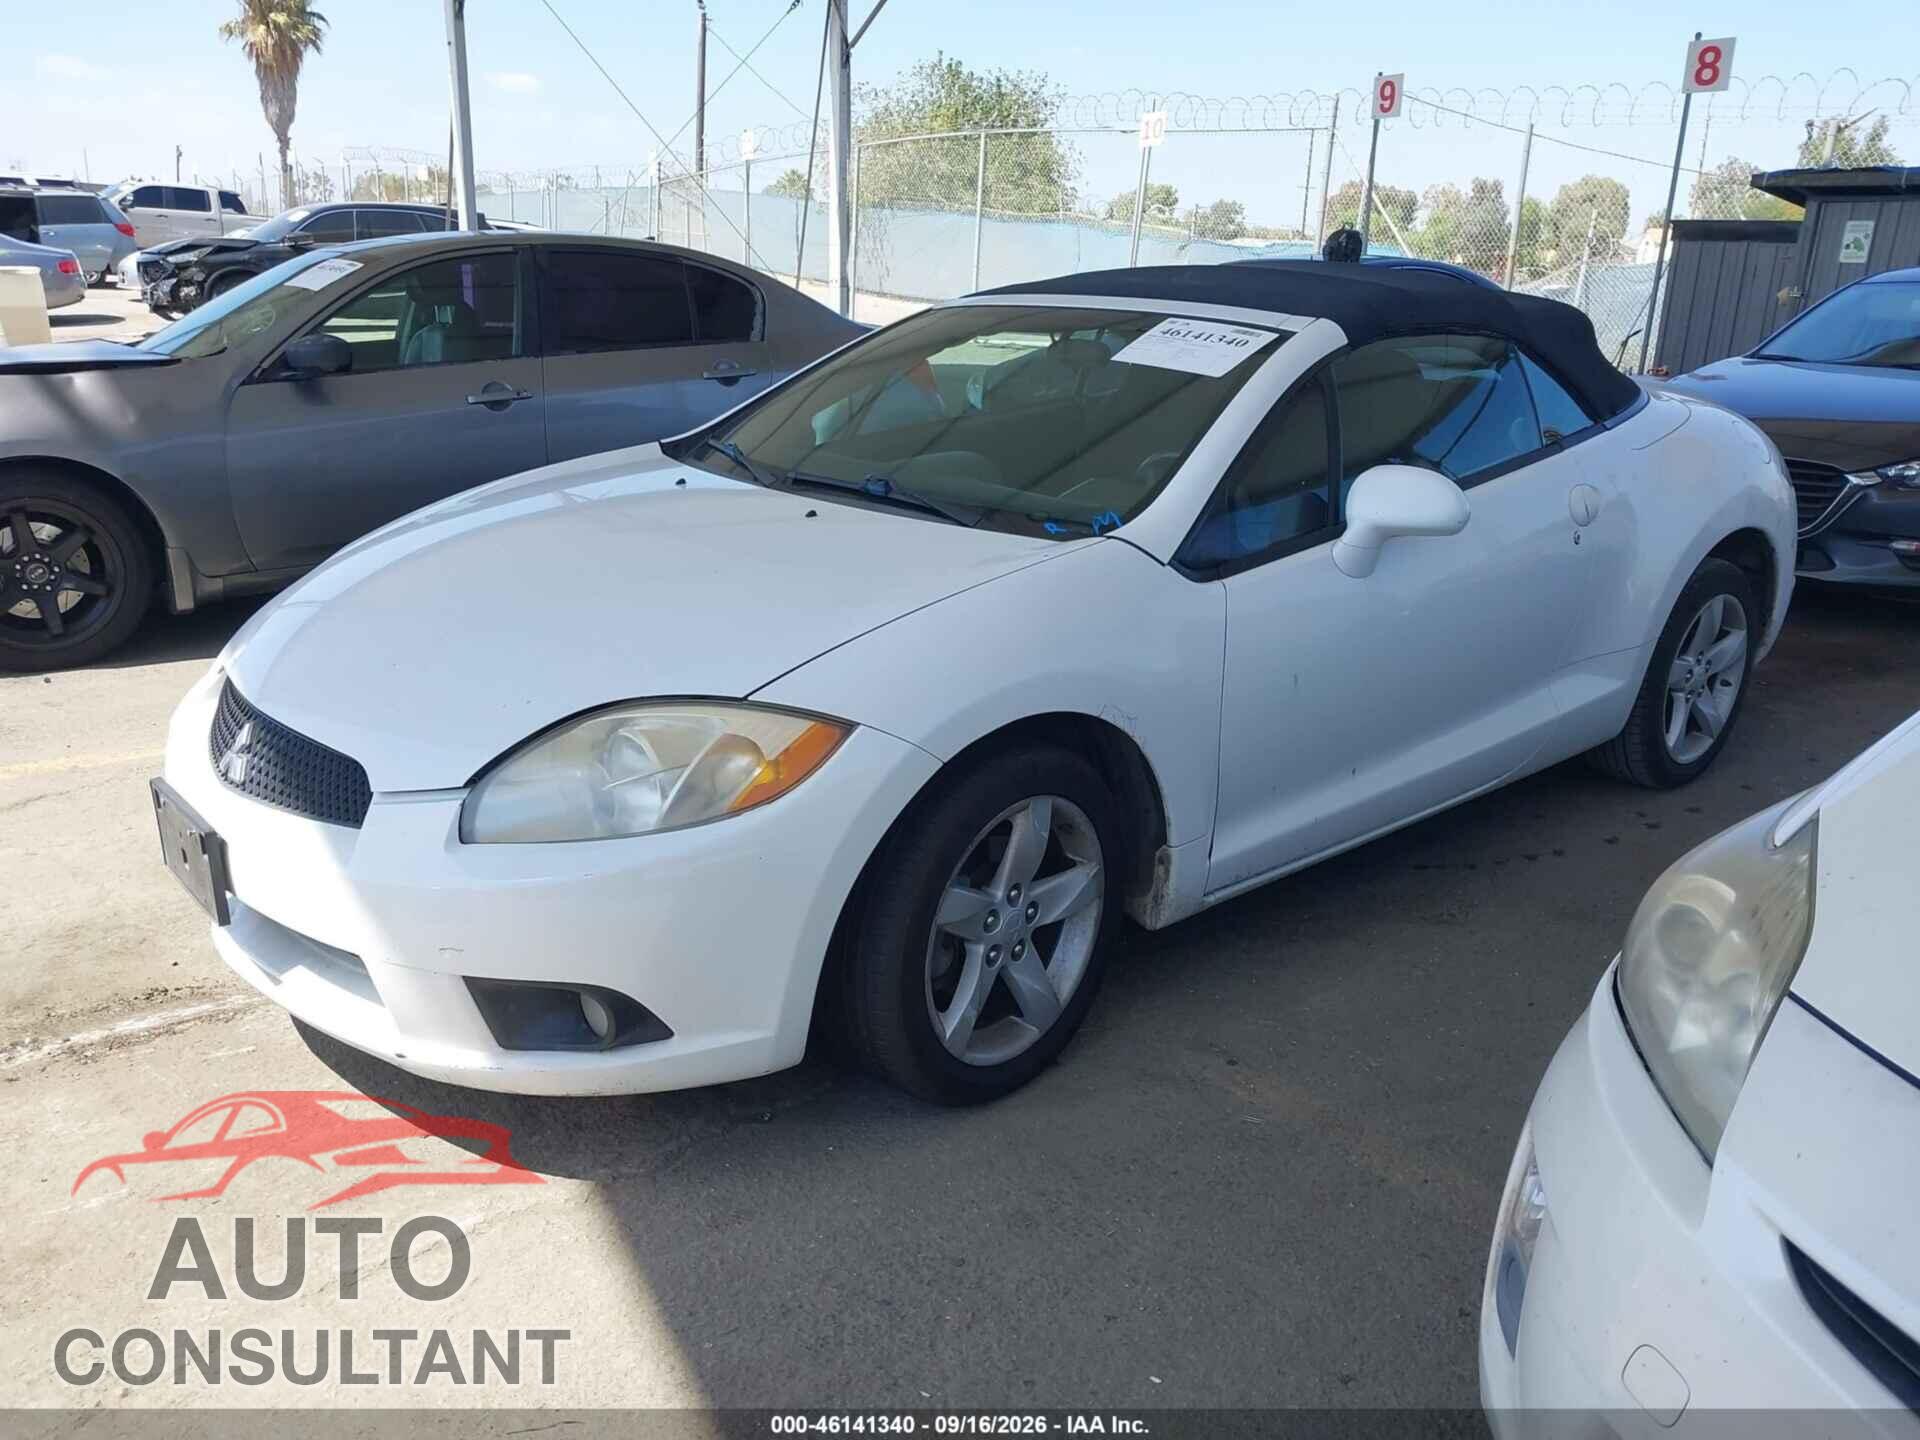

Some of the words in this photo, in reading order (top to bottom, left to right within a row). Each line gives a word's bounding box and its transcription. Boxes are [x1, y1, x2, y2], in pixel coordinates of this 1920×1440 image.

[1695, 45, 1722, 87] 8
[1379, 80, 1396, 114] 9
[1143, 118, 1164, 140] 10
[1160, 326, 1250, 348] 46141340
